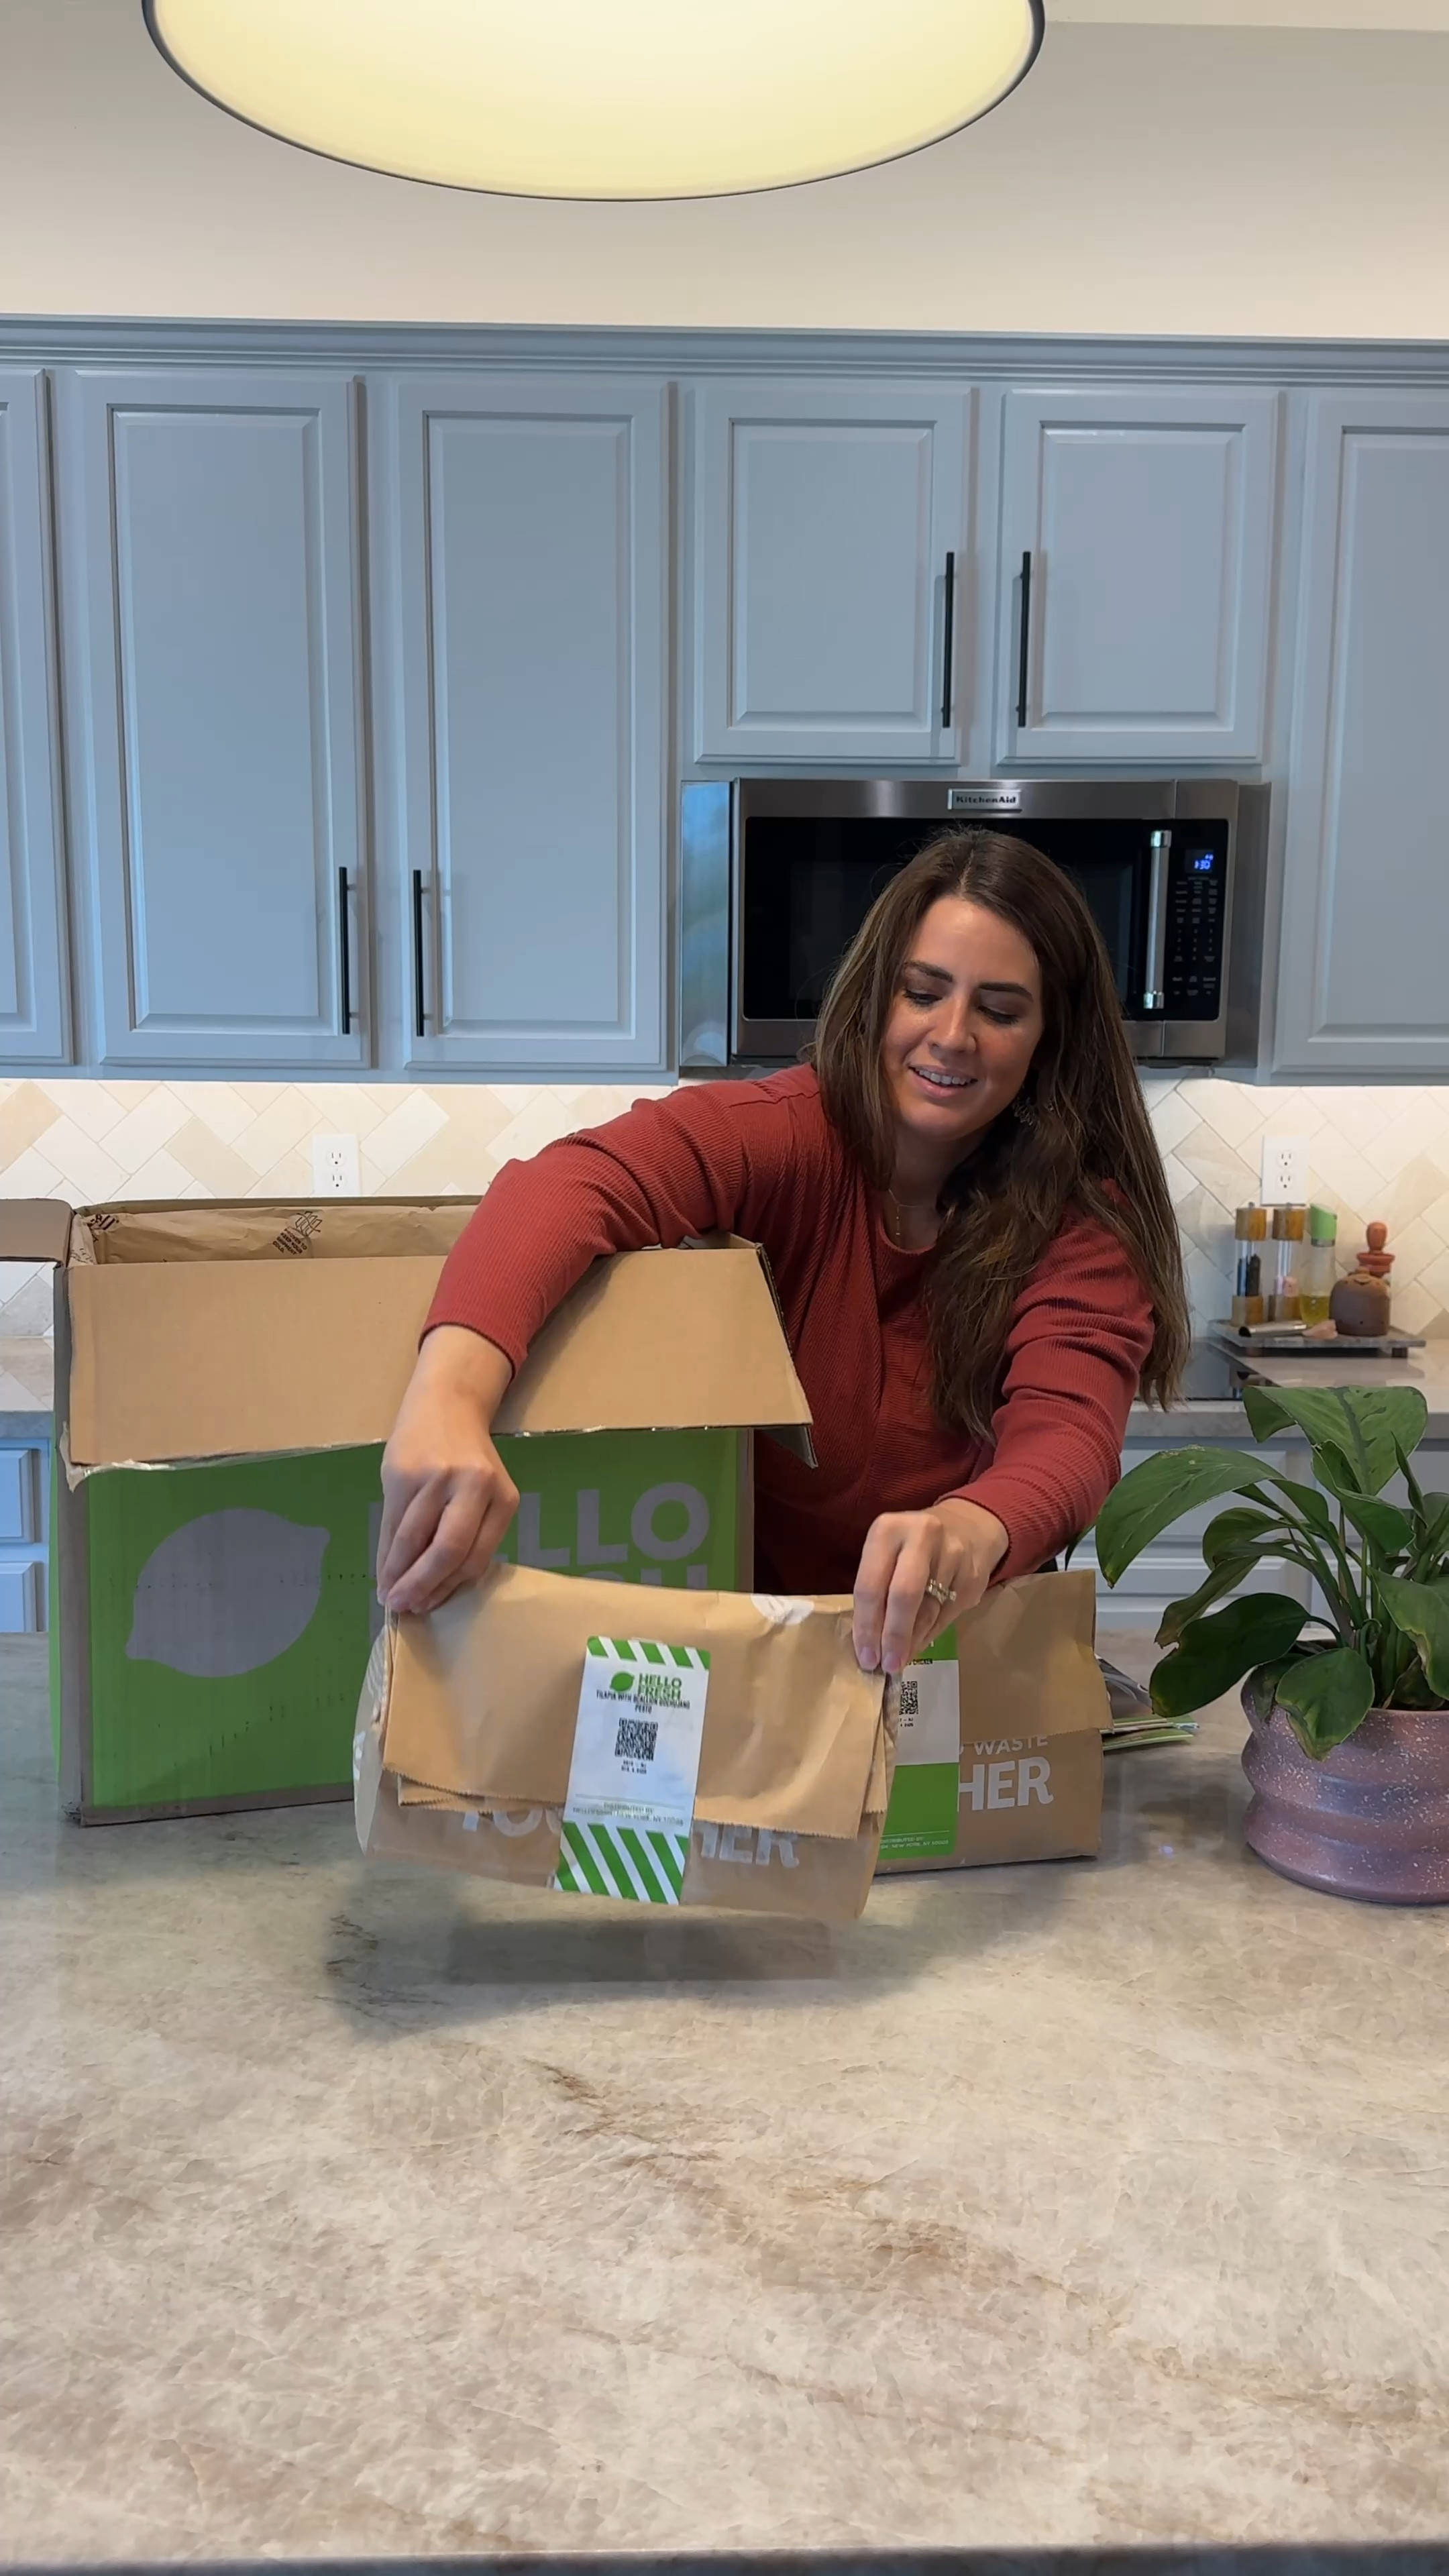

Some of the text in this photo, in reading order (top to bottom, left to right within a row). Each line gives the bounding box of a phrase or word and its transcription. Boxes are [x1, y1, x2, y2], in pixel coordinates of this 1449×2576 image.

[639, 1673, 682, 1688] HELLO
[596, 1689, 616, 1701] TILAPIA
[618, 1693, 632, 1702] WITH
[637, 1684, 682, 1700] FRESH
[974, 1734, 1049, 1756] WASTE
